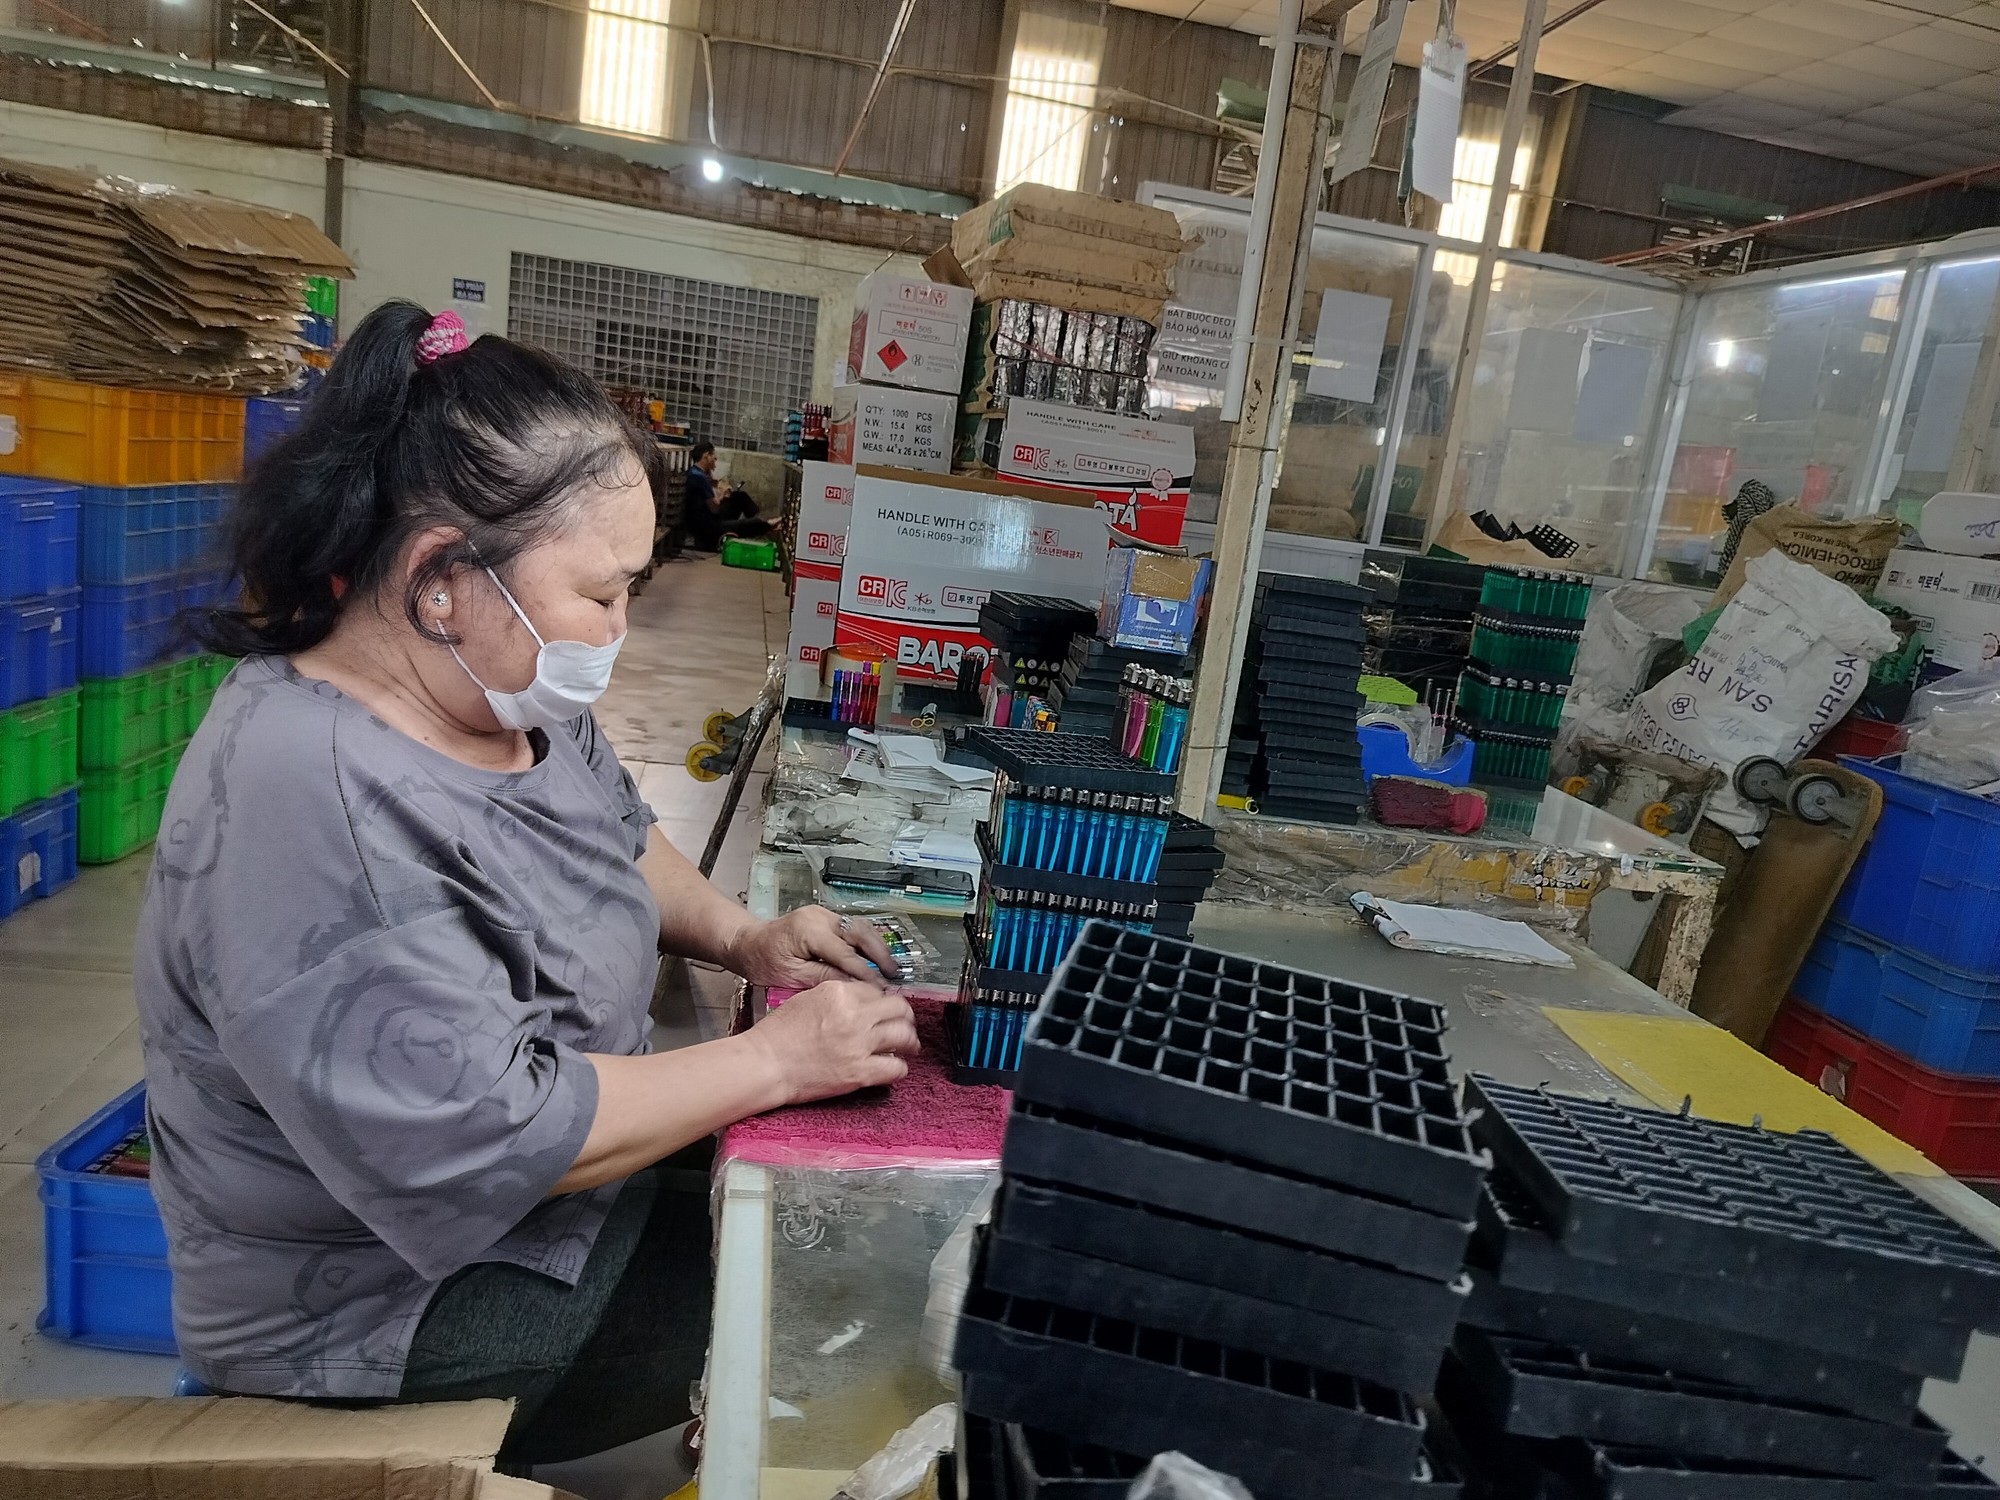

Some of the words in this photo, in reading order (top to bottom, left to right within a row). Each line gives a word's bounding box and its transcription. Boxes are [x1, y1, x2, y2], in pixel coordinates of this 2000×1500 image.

[1201, 328, 1216, 338] KHI
[1160, 364, 1173, 373] AN
[1175, 366, 1200, 378] TOÀN
[1201, 371, 1207, 380] 2
[1207, 372, 1217, 381] M
[892, 409, 909, 418] 1000
[916, 412, 933, 421] PCS
[1026, 411, 1064, 422] HANDLE
[1066, 417, 1090, 426] WITH
[1091, 422, 1117, 431] CARE
[891, 421, 905, 430] 15.4
[915, 424, 932, 434] KGS
[890, 433, 904, 443] 17.0
[914, 437, 932, 446] KGS
[862, 442, 885, 453] MEAS:
[904, 447, 911, 456] 26
[1014, 447, 1034, 460] CR
[826, 488, 841, 499] CR
[877, 508, 930, 526] HANDLE
[933, 516, 965, 532] WITH
[810, 535, 828, 548] CR
[1793, 531, 1823, 543] KOREA
[1824, 538, 1835, 546] IN
[860, 578, 885, 596] CR
[959, 595, 974, 604] 투명
[818, 603, 833, 614] CR
[801, 647, 819, 660] CR
[898, 636, 998, 676] BARO
[1718, 675, 1773, 713] SAN
